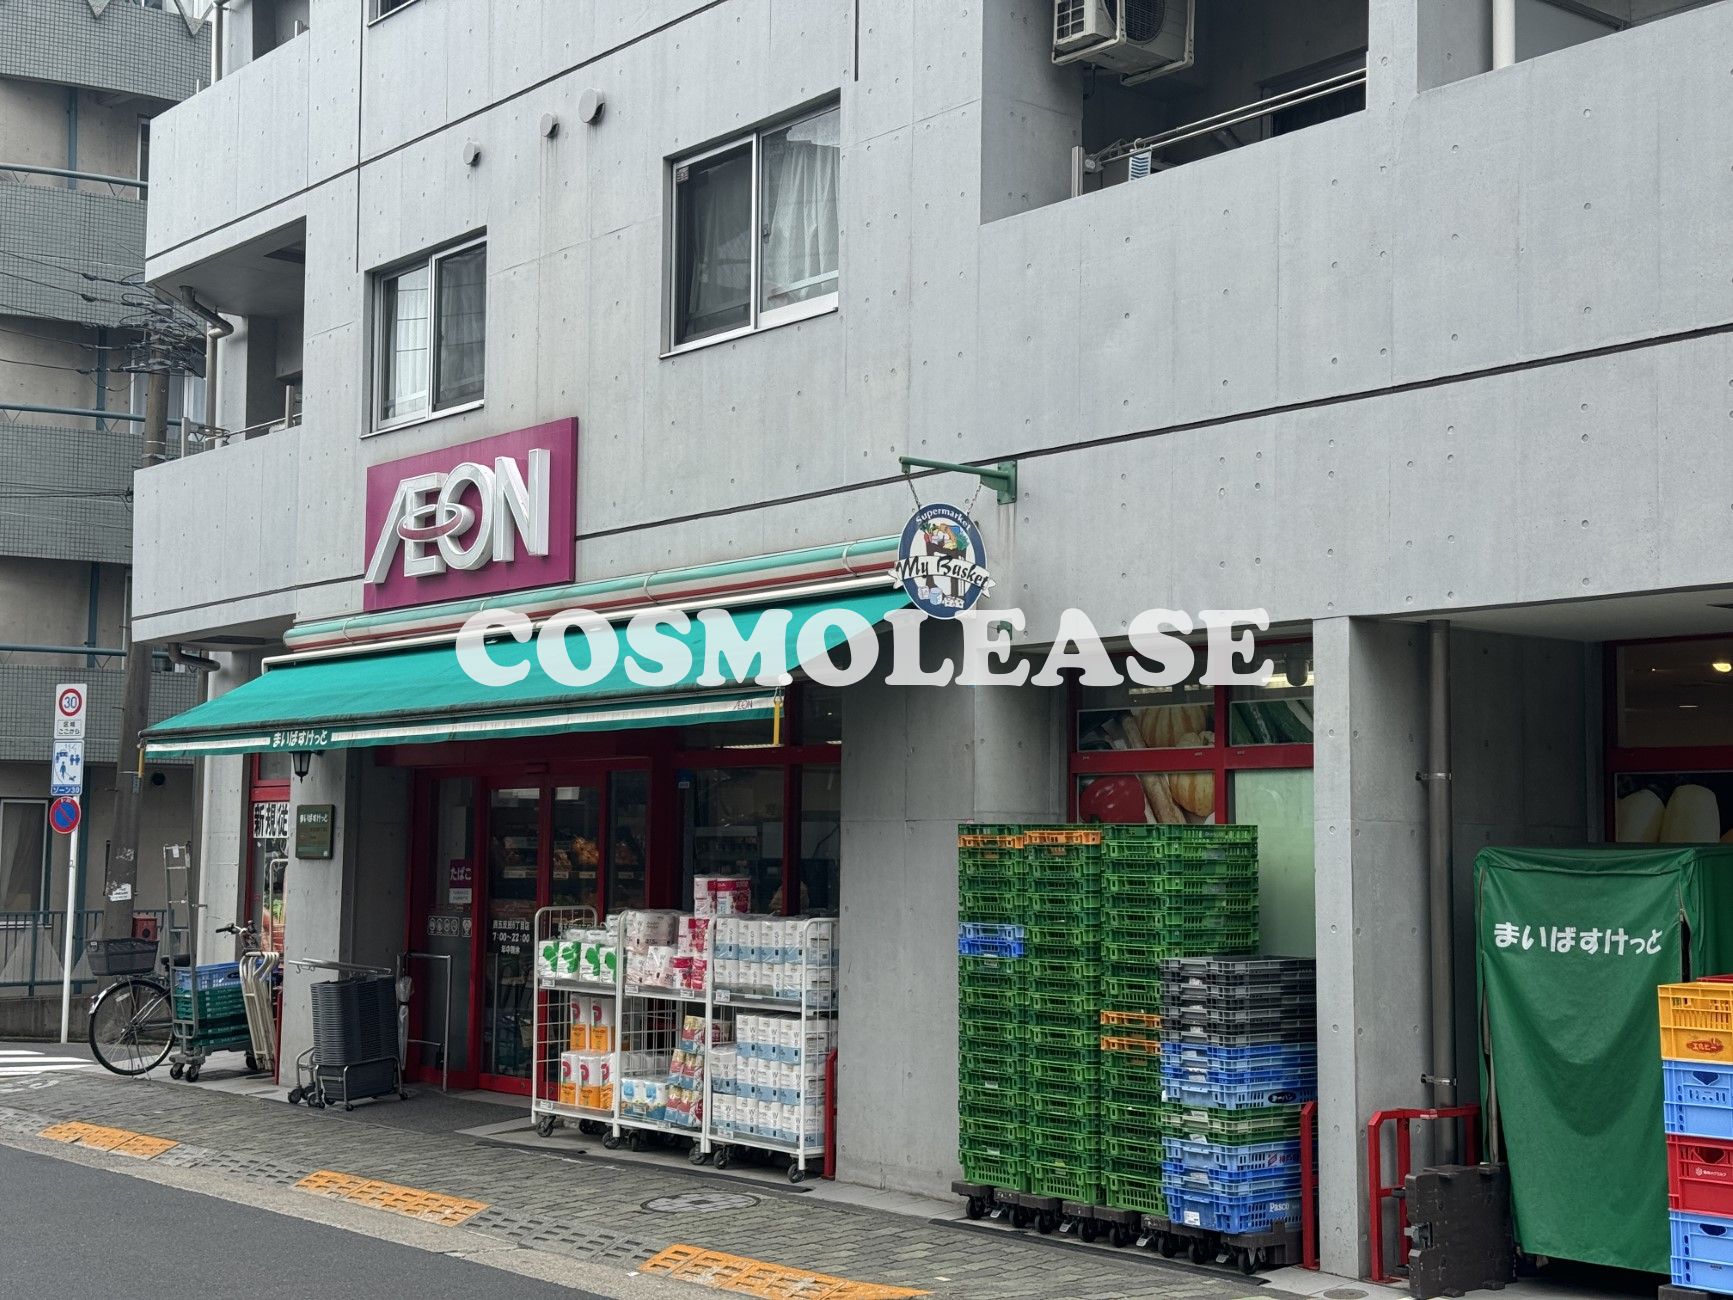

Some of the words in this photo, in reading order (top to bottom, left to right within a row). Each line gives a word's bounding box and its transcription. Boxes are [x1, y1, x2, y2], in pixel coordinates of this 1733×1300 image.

[915, 508, 972, 531] Supermarket
[896, 555, 929, 578] My
[937, 554, 990, 590] Basket
[64, 696, 77, 709] 30
[272, 729, 328, 748] まいばすけっと
[450, 866, 472, 881] たばこ
[1493, 922, 1663, 956] まいばすけっと
[1269, 1201, 1290, 1213] Pasco
